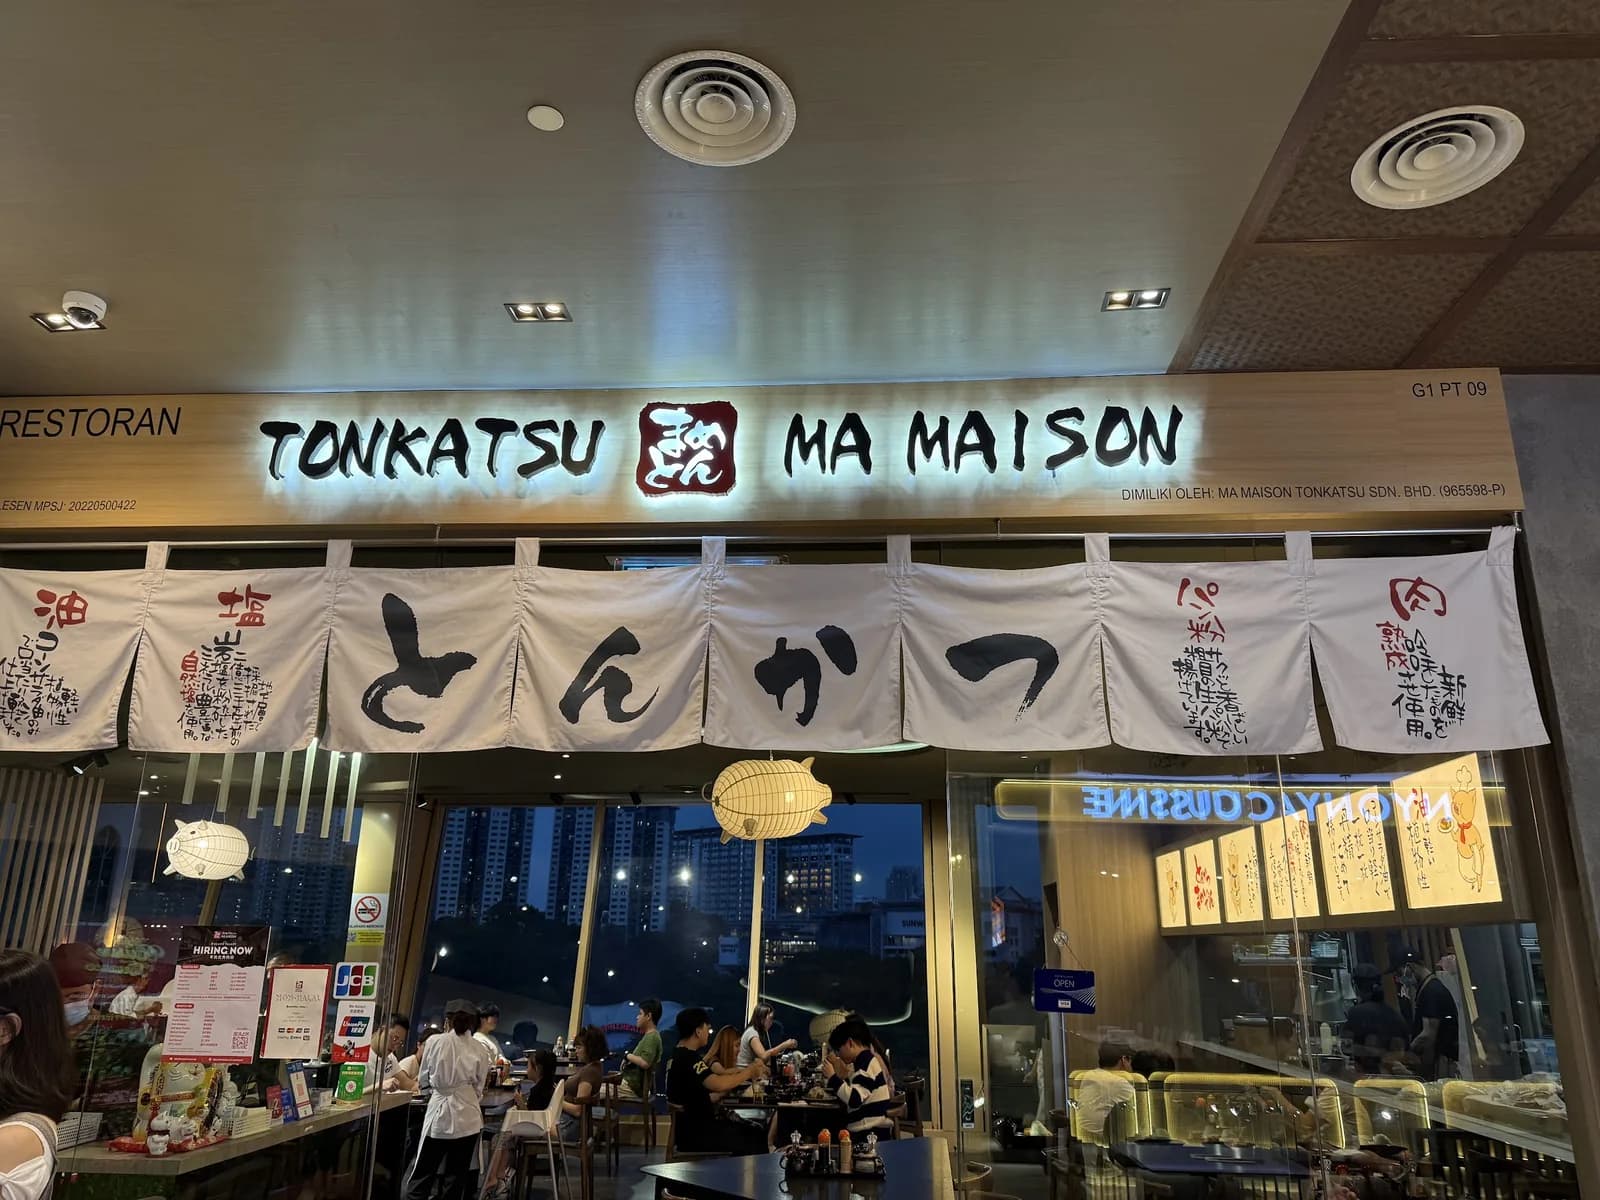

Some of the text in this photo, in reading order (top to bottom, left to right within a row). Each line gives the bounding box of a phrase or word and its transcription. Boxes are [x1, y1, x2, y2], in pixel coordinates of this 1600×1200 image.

[1412, 381, 1487, 397] G1 PT 09
[0, 407, 181, 438] RESTORAN
[259, 417, 605, 480] TONKATSU
[784, 404, 1183, 478] MA MAISON
[1121, 483, 1505, 501] DIMILIKI OLEH: MA MAISON TONKATSU SDN. BHD. (965598-P)
[0, 501, 31, 511] ESEN
[68, 500, 137, 512] 20220500422
[34, 589, 89, 630] 油
[218, 584, 272, 627] 塩
[193, 945, 254, 955] HIRING NOW
[337, 975, 374, 987] JCB
[1053, 979, 1075, 988] OPEN
[693, 1060, 708, 1075] 23
